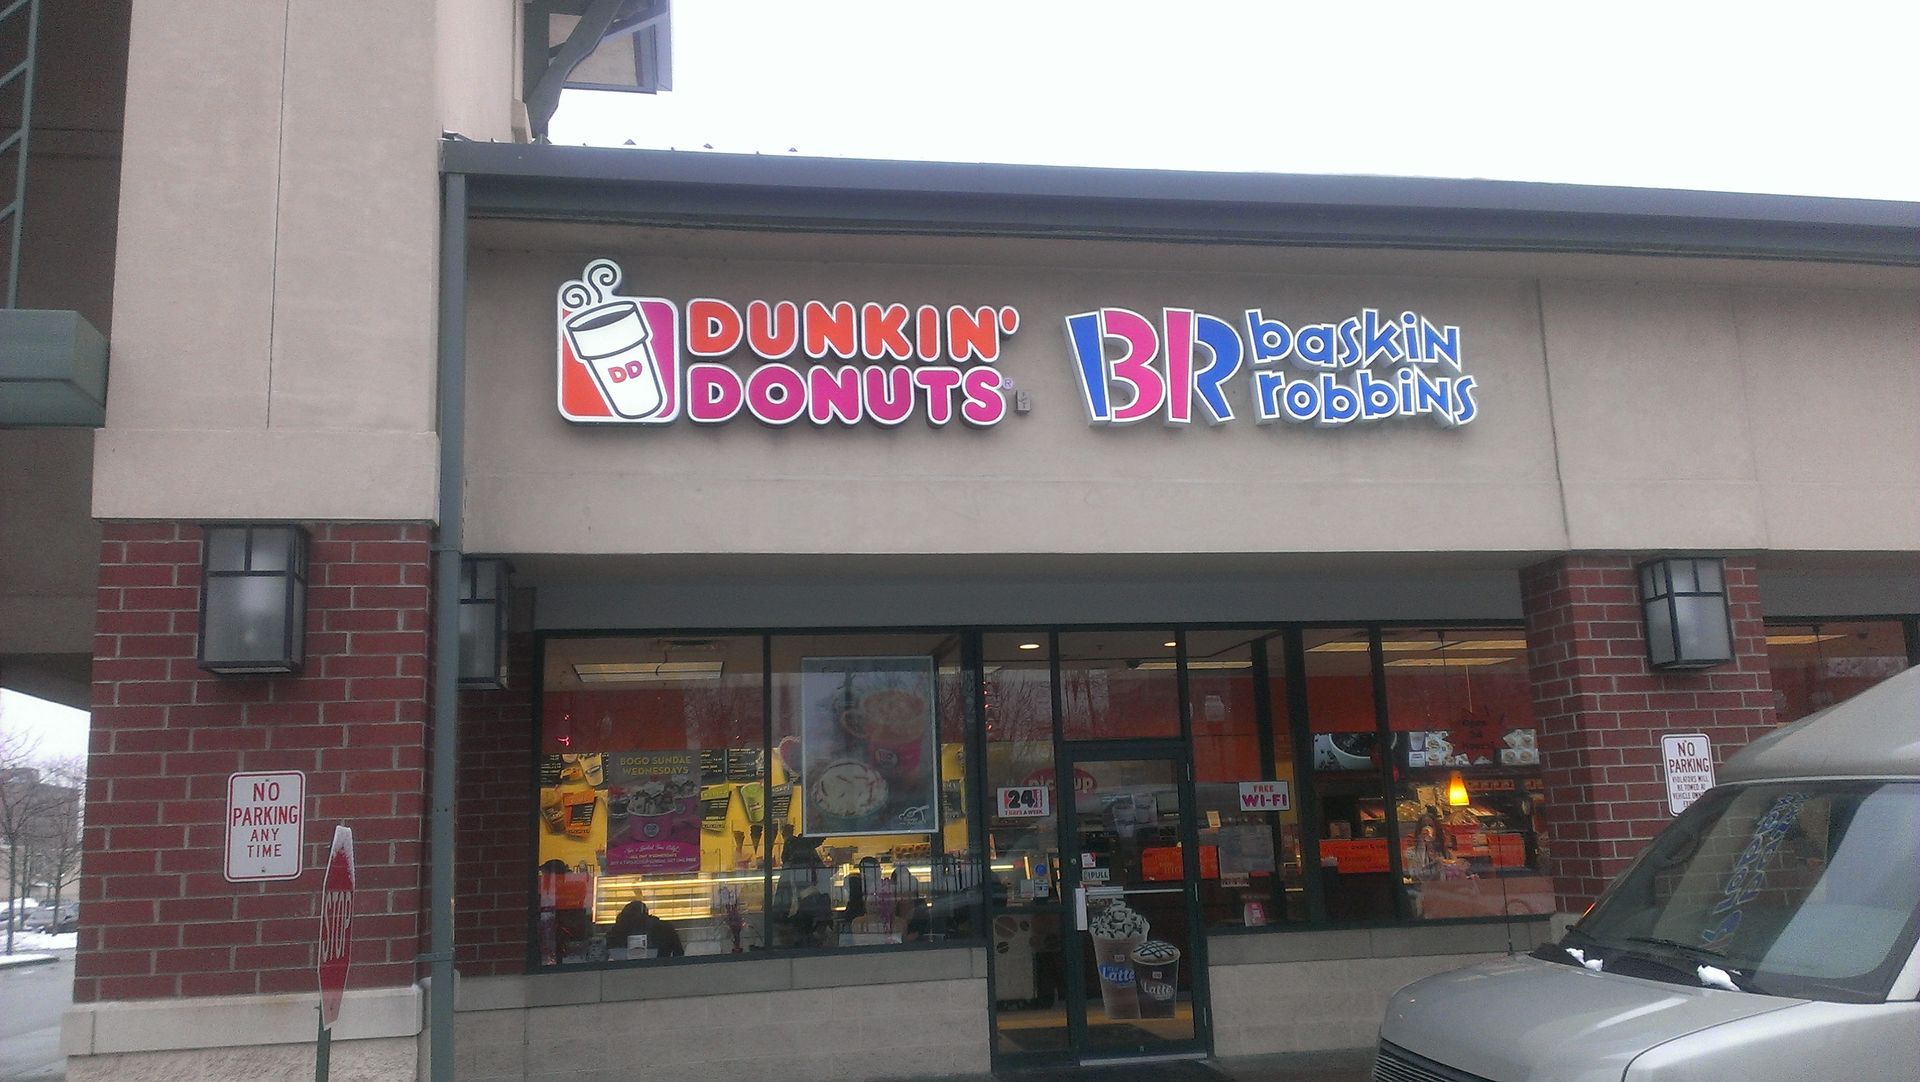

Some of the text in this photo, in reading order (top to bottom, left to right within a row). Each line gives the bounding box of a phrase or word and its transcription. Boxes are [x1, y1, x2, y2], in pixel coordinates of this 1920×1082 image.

[687, 298, 1020, 363] DUNKIN'
[1244, 308, 1460, 372] baskin
[608, 360, 642, 383] DD
[1065, 307, 1243, 424] BR
[687, 362, 1006, 425] DONUTS
[1254, 365, 1478, 425] robbins
[1677, 741, 1695, 757] NO
[620, 755, 692, 766] BOGO SUNDAE
[1668, 758, 1709, 774] PARKING
[623, 766, 689, 776] WEDNESDAYS
[253, 782, 280, 802] NO
[1253, 785, 1274, 793] FREE
[1007, 789, 1036, 809] 24
[1242, 794, 1287, 808] WI-FI
[232, 805, 299, 827] PARKING
[250, 828, 280, 842] ANY
[247, 844, 282, 858] TIME
[1091, 871, 1108, 880] PULL
[322, 891, 352, 963] STOP
[1102, 966, 1136, 982] Latte
